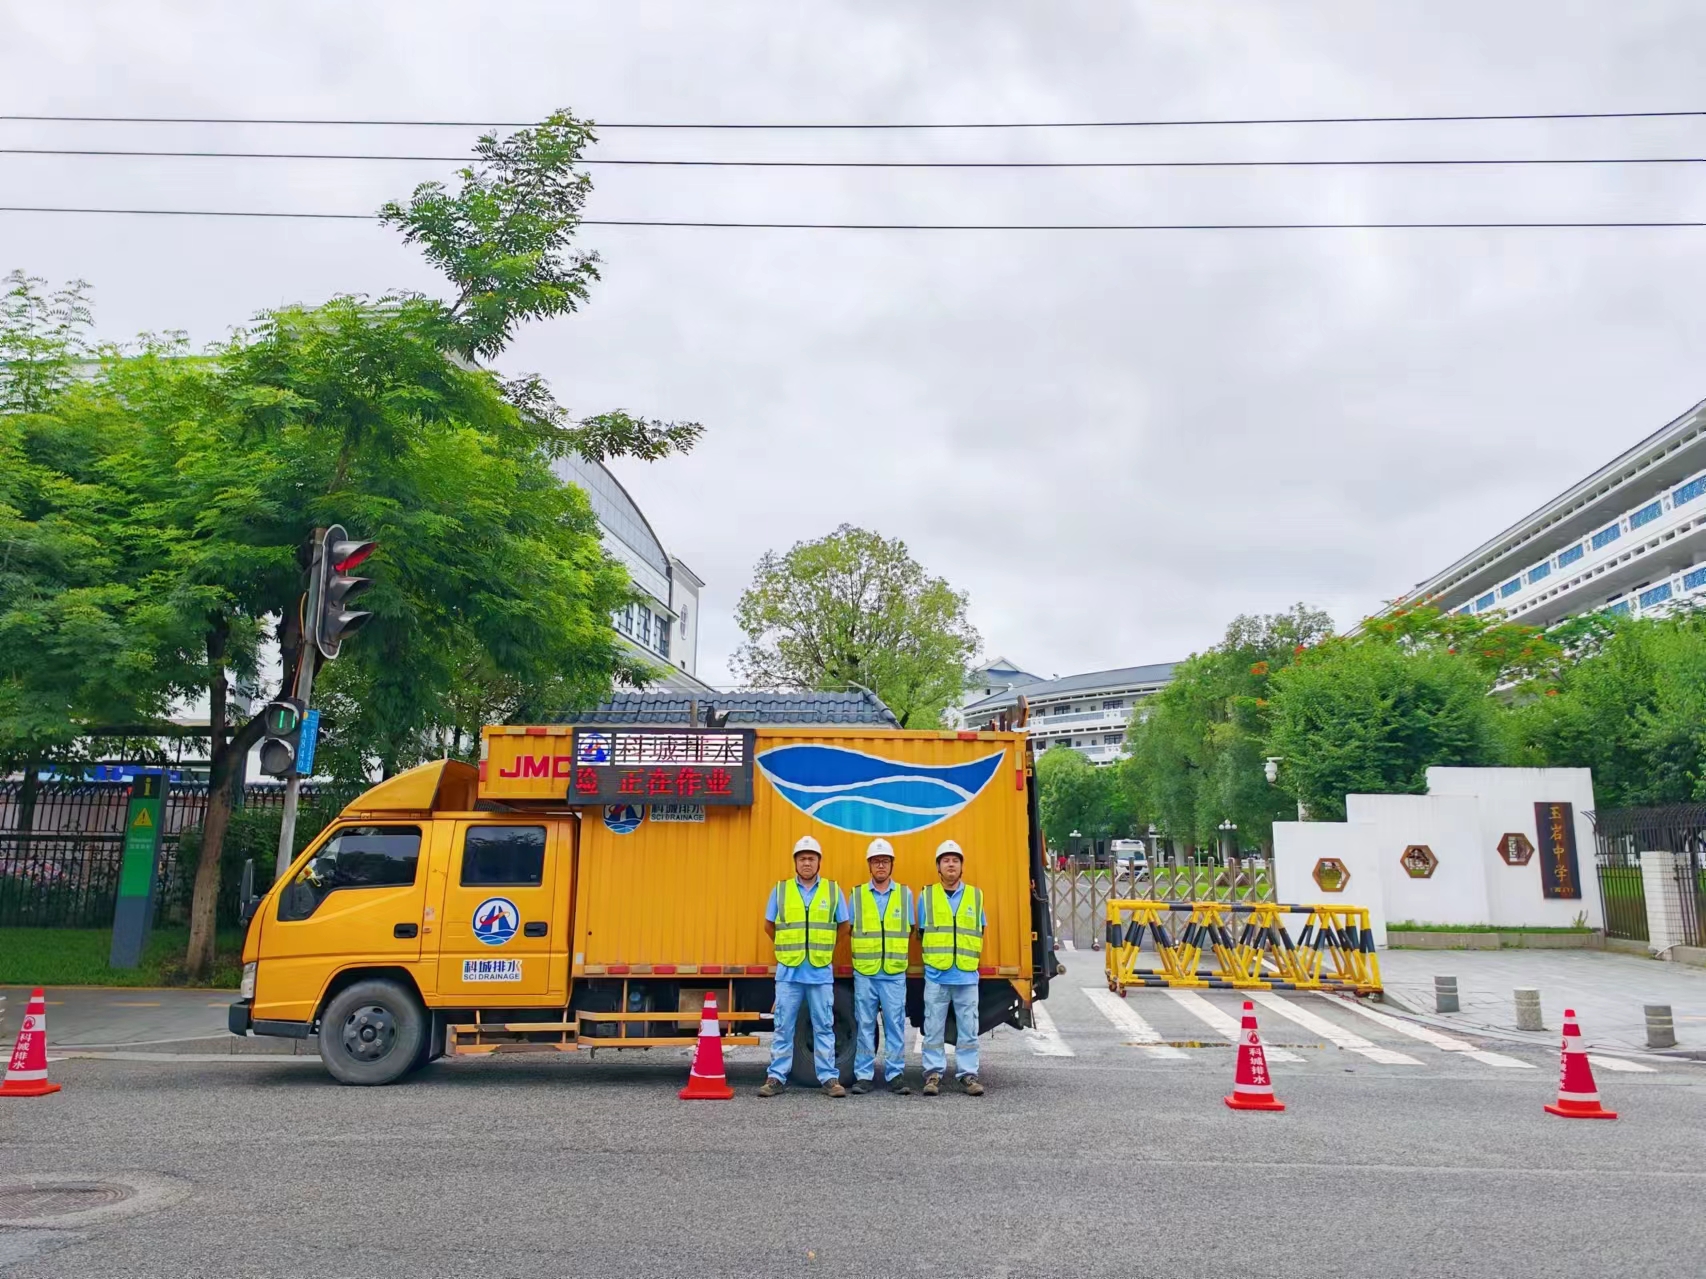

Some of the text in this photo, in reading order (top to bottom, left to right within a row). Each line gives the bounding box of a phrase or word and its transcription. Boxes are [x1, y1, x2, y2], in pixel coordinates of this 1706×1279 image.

[619, 735, 740, 764] 科城排水
[616, 767, 733, 796] 正在作业
[464, 960, 520, 973] 科城排水
[12, 1032, 32, 1070] 科城排水
